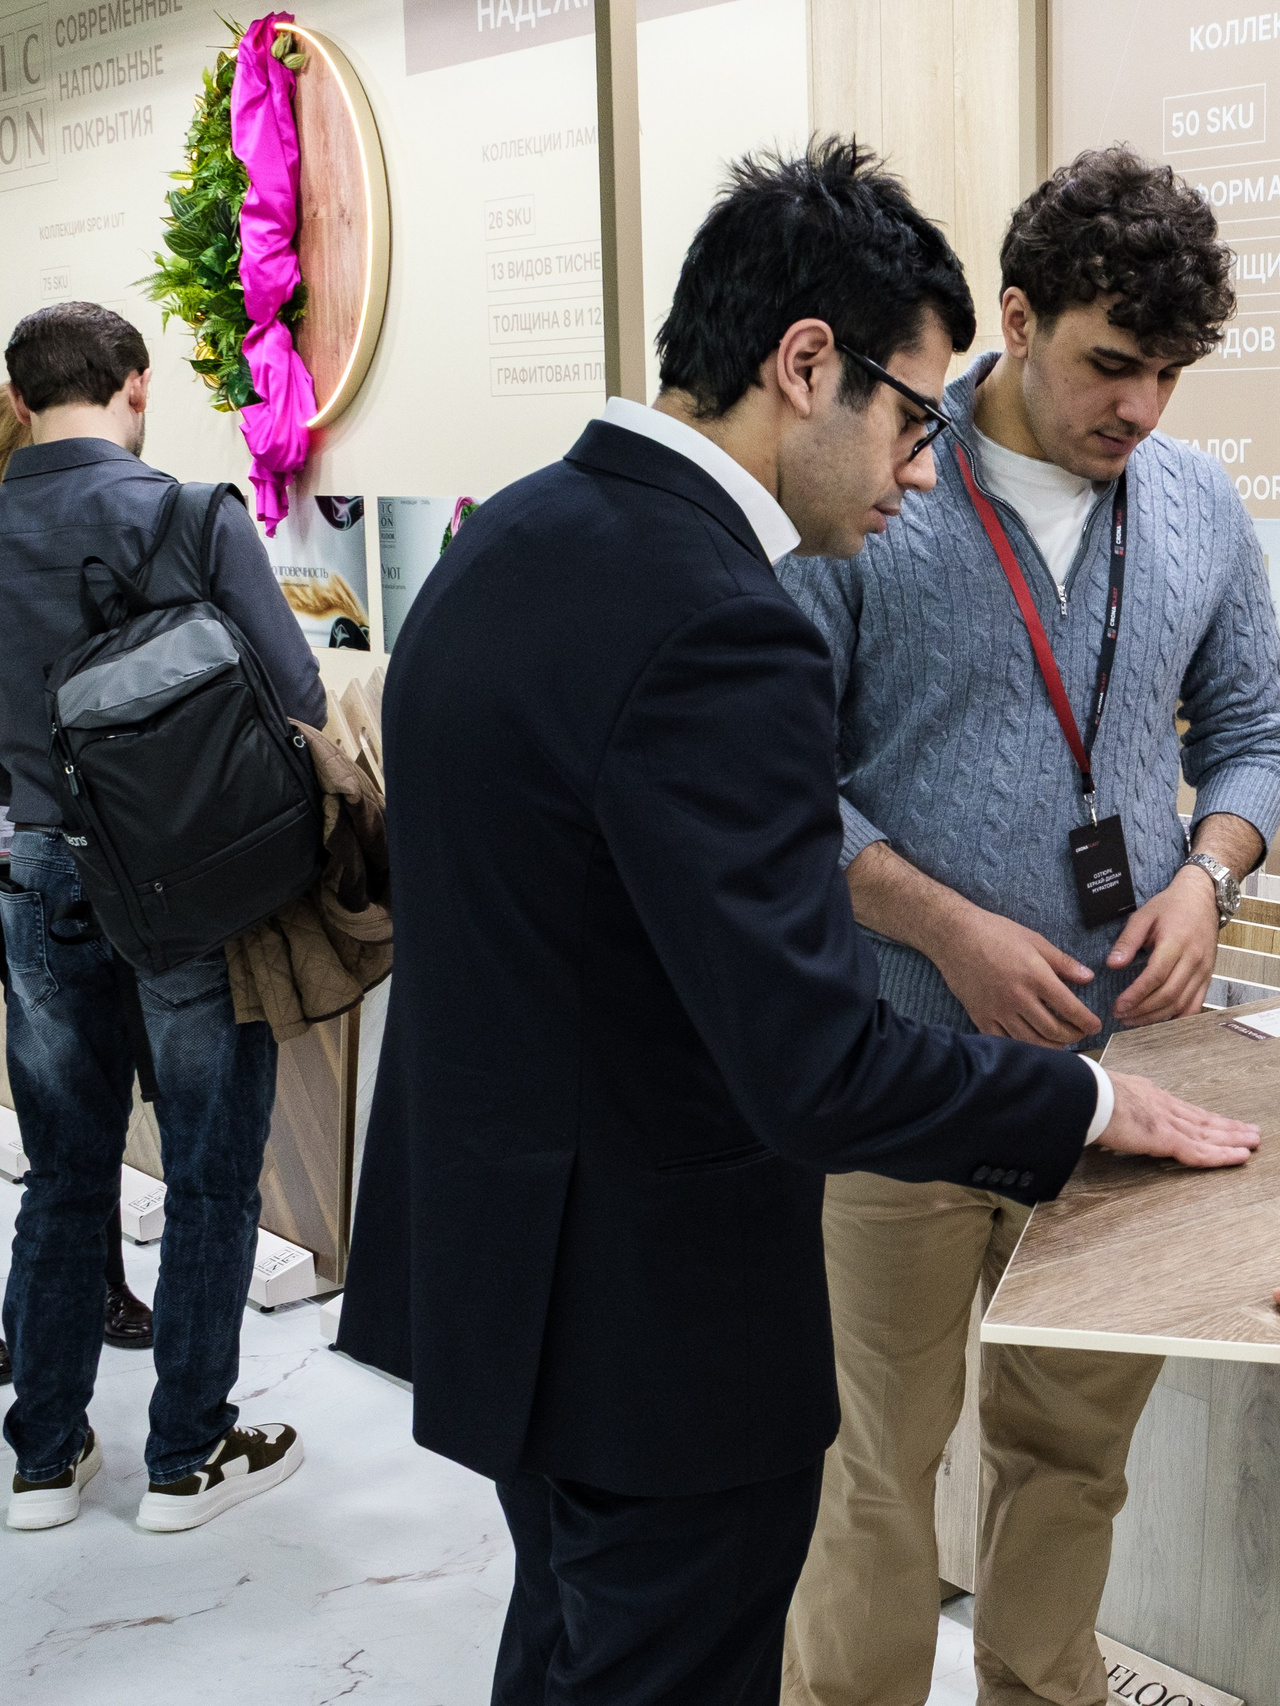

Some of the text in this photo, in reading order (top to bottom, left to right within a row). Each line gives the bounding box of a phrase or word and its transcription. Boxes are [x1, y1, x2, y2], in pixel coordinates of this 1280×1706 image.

[58, 44, 164, 101] НАПОЛЬНЫЕ
[62, 104, 154, 154] ПОКРЫТИЯ
[1170, 102, 1255, 139] 50 SKU
[482, 131, 562, 162] КОЛЛЕКЦИИ
[39, 220, 86, 241] КОЛЛЕКЦИИ
[87, 215, 103, 232] SPC
[112, 212, 126, 228] LVT
[488, 206, 532, 230] 26 SKU
[491, 251, 601, 281] 13 ВИДОВ ТИСНЕ
[42, 275, 69, 291] 75 SKU
[493, 307, 602, 334] ТОЛЩИНА 8 И 12
[1218, 326, 1275, 359] ДОВ
[497, 363, 580, 385] ГРАФИТОВАЯ
